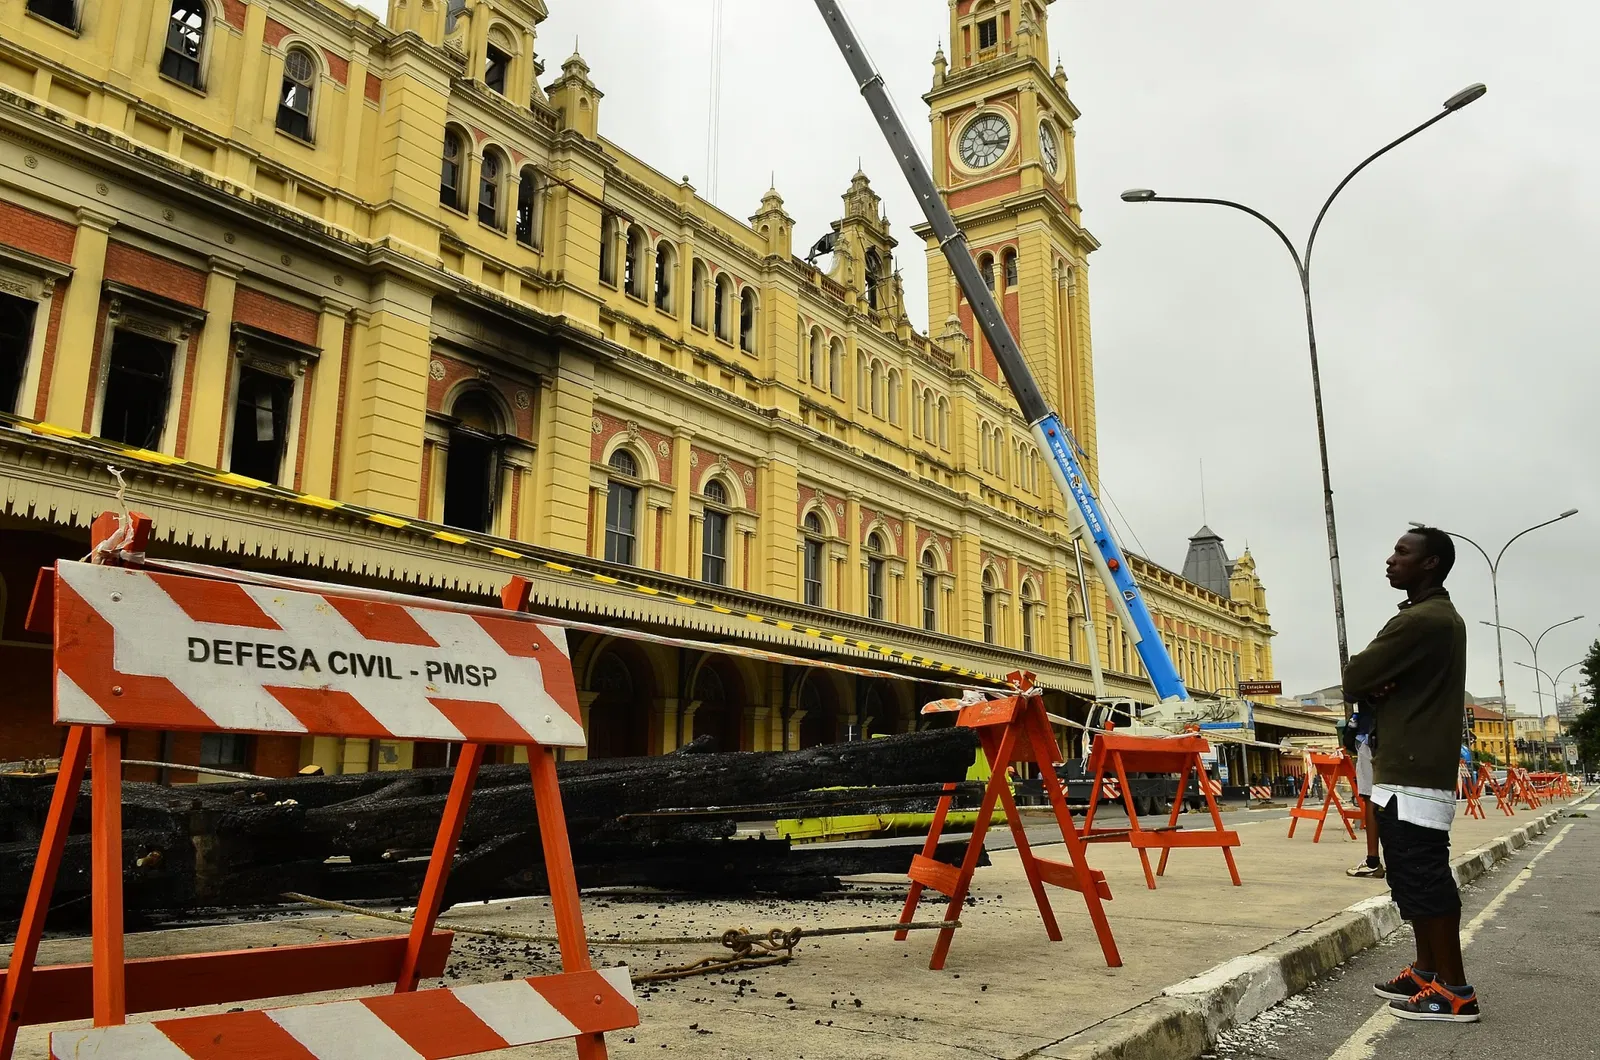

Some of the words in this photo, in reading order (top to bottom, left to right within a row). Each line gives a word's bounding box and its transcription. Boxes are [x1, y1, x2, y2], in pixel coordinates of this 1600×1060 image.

[188, 637, 321, 672] DEFESA
[328, 651, 402, 680] CIVIL
[426, 661, 497, 687] PMSP
